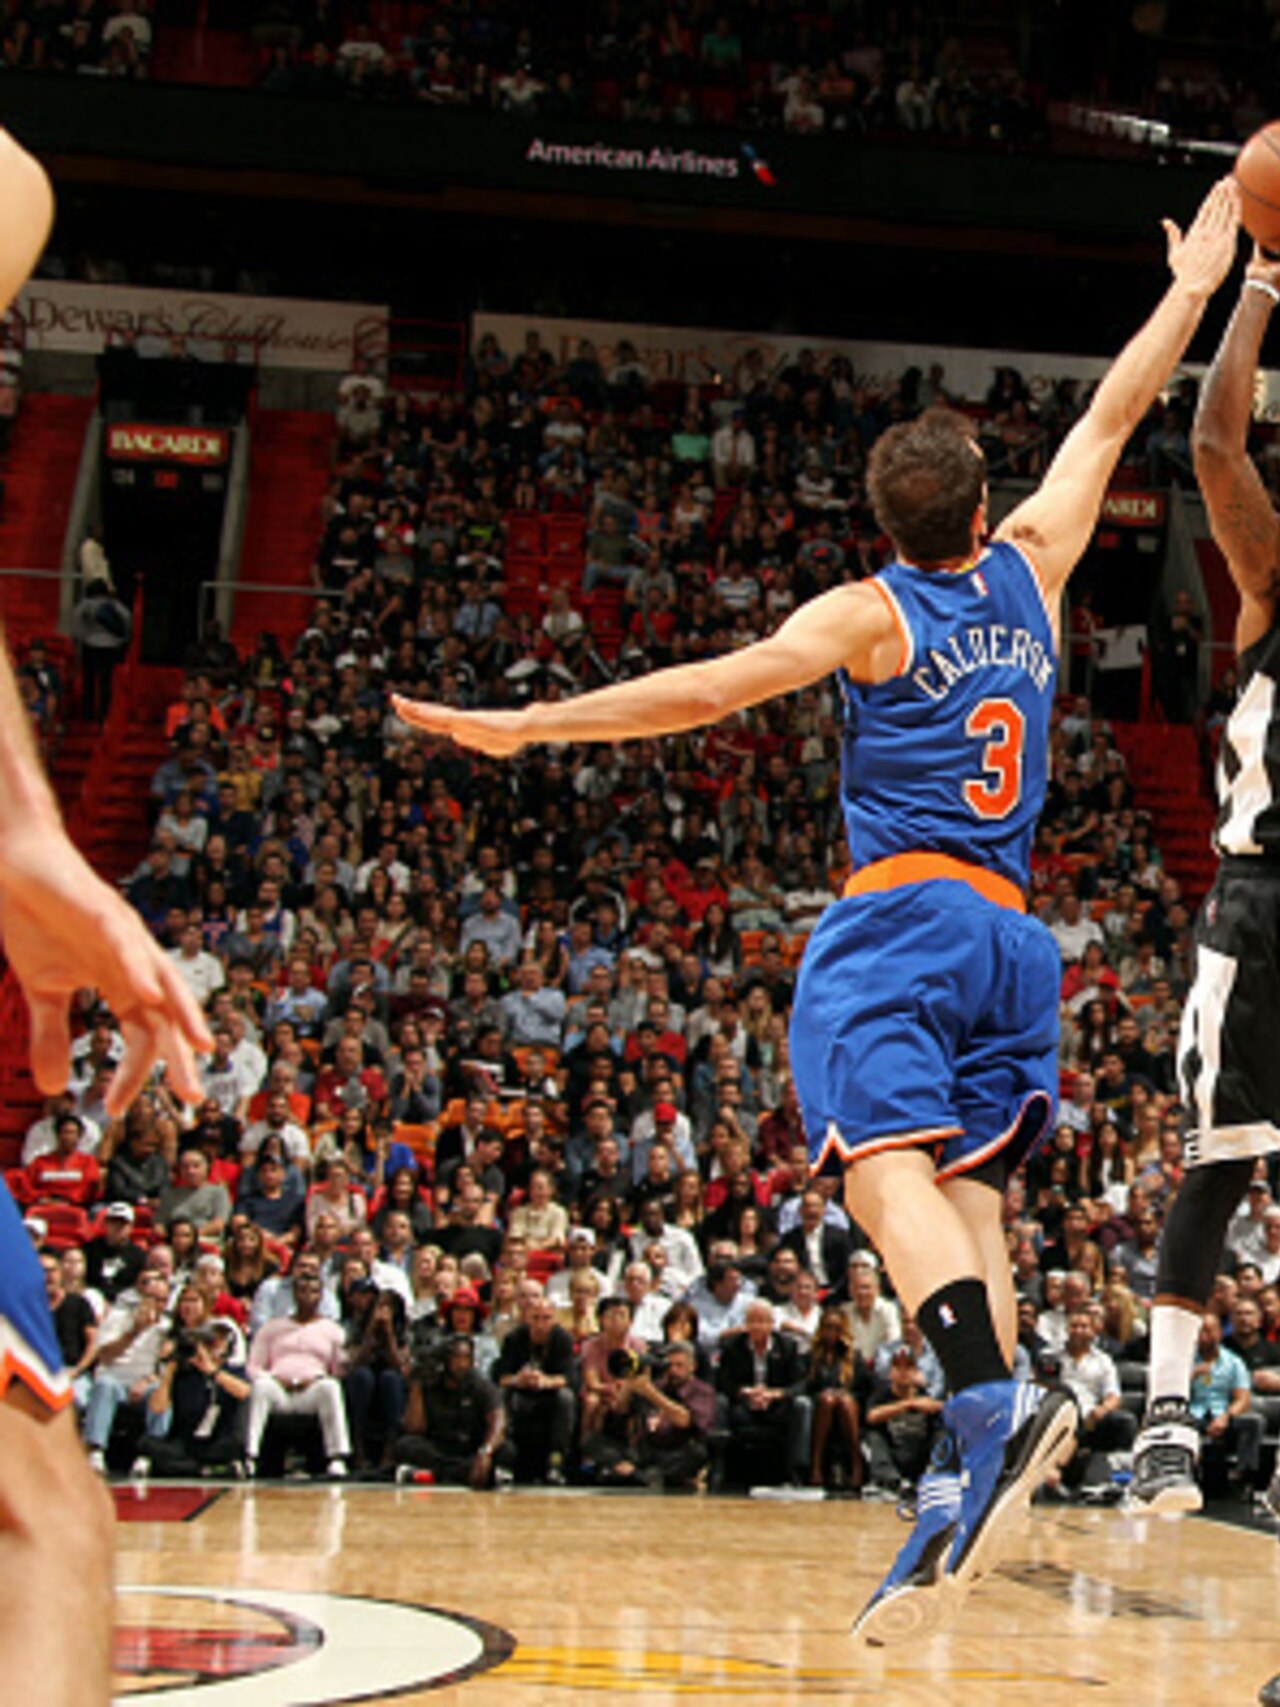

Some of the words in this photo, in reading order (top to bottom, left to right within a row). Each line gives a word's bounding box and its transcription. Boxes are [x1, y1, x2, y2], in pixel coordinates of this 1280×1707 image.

[526, 137, 643, 170] American
[646, 147, 739, 178] Airlines
[110, 428, 222, 457] BACARDI
[1103, 497, 1157, 519] ARDI
[912, 624, 1055, 703] CALDERON
[962, 697, 1026, 820] 3
